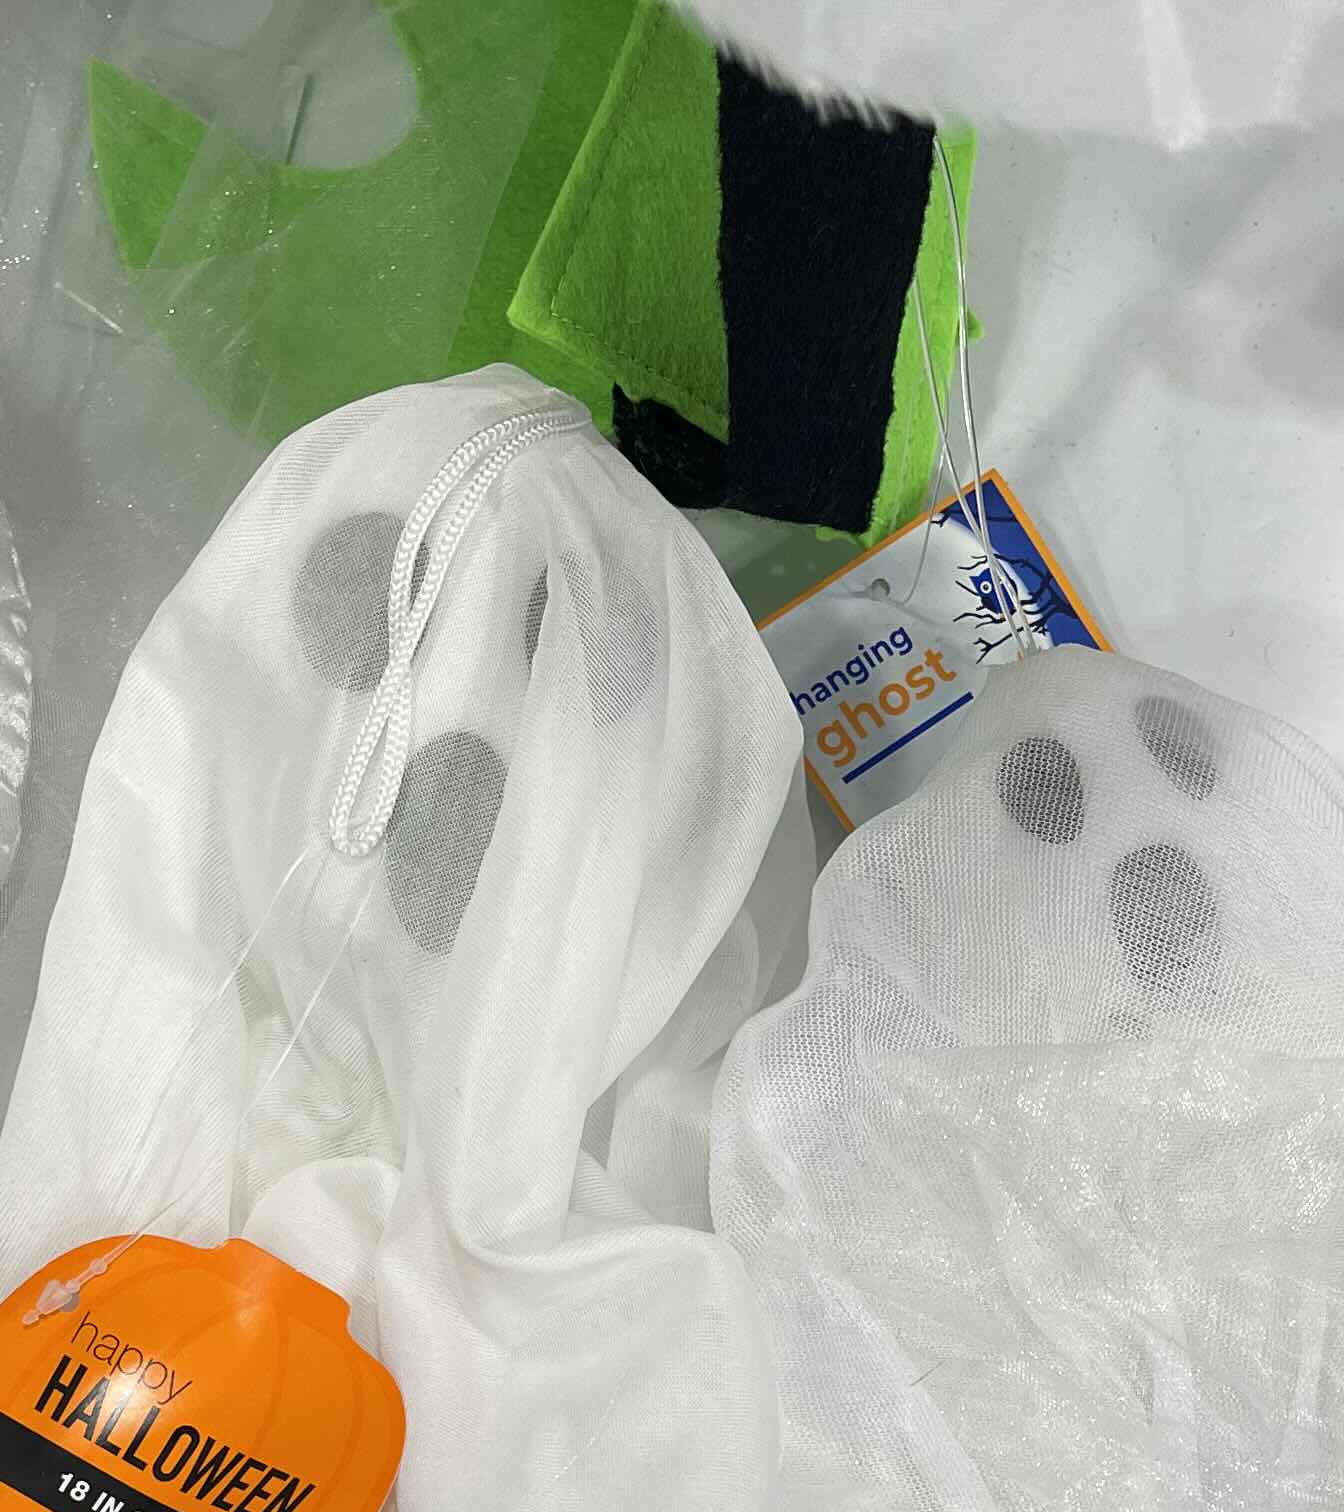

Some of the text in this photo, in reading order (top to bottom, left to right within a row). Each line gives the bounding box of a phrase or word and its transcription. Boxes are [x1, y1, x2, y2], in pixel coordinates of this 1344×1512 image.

[789, 626, 913, 715] hanging
[816, 648, 958, 768] ghost
[70, 1311, 193, 1405] happy
[58, 1472, 90, 1501] 18
